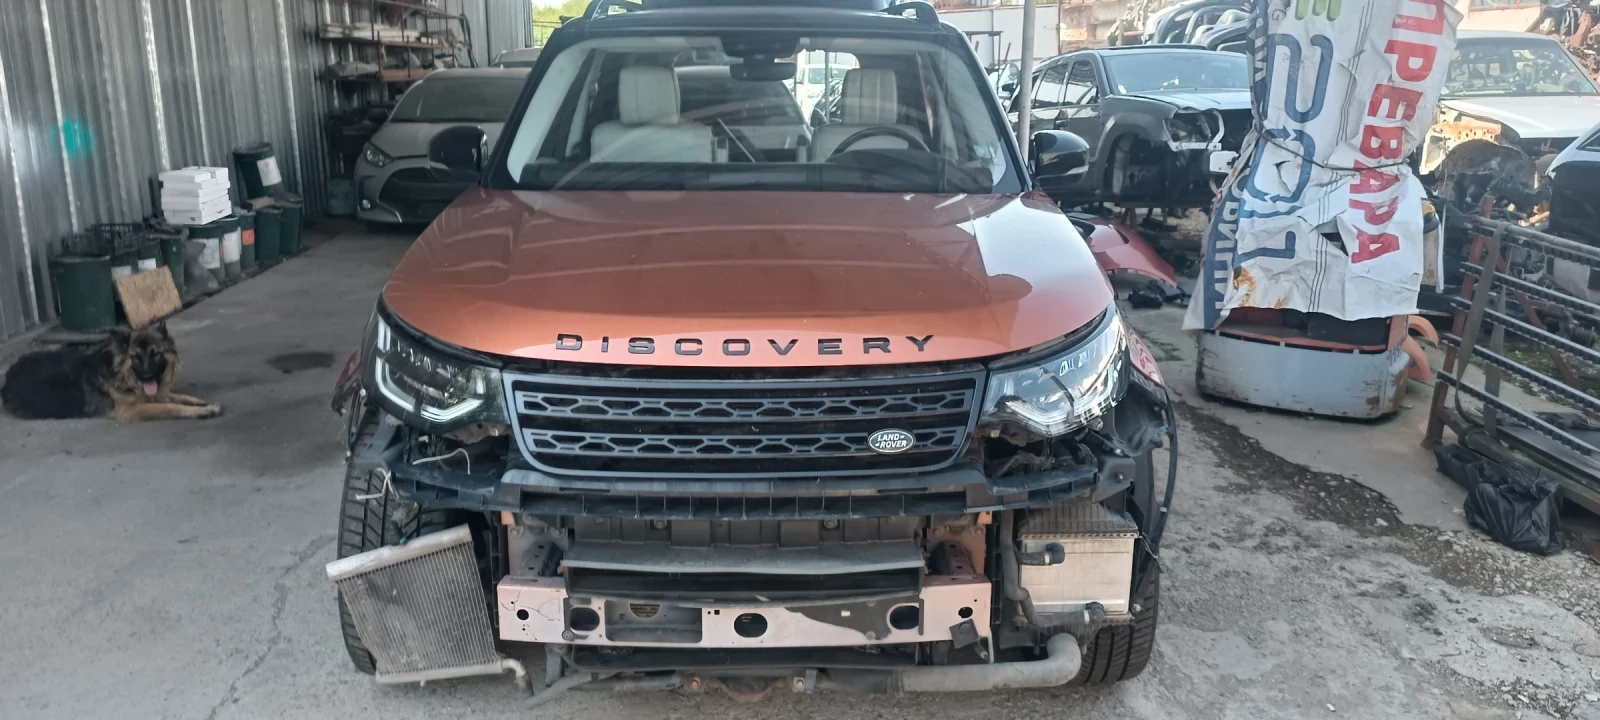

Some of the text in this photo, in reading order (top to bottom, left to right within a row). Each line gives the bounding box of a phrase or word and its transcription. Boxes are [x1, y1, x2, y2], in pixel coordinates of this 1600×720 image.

[556, 333, 934, 356] DISCOVERY
[877, 433, 900, 442] LAND
[879, 440, 907, 449] ROVER
